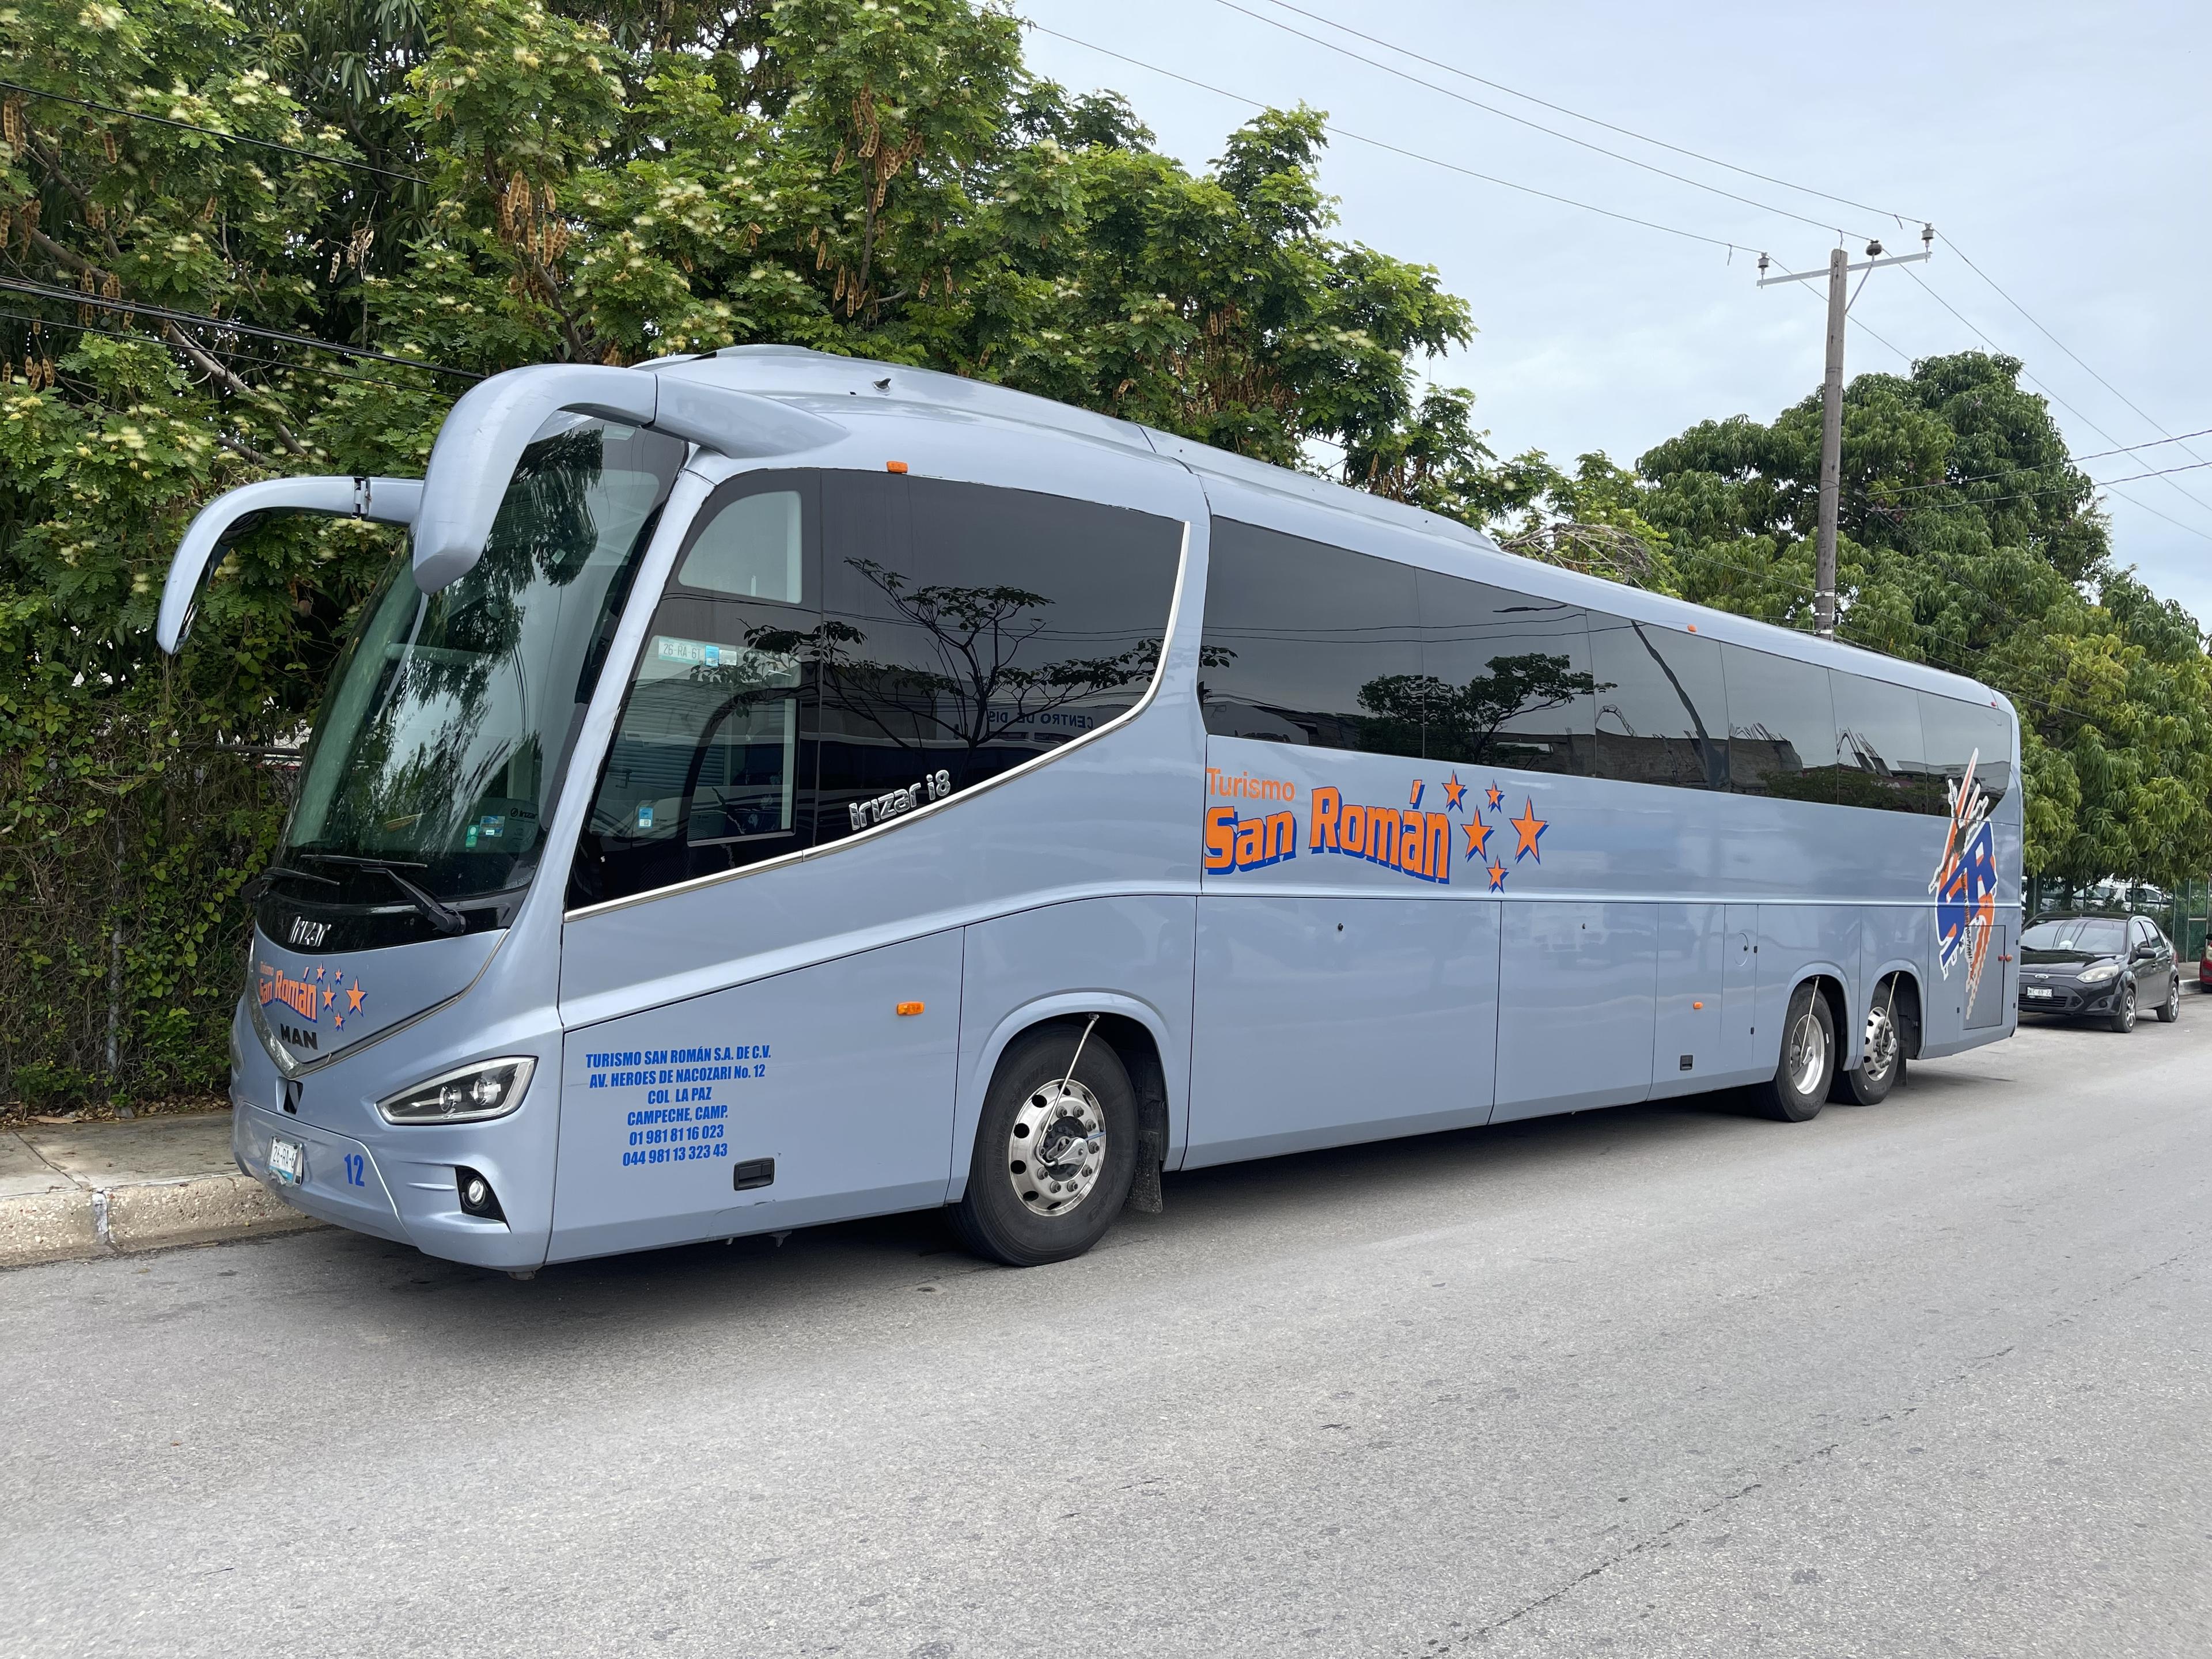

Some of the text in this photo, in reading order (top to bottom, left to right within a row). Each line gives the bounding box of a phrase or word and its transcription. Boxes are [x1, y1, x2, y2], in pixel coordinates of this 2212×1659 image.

[663, 643, 701, 660] 26-RA-6T
[926, 769, 951, 801] i8
[1206, 767, 1296, 801] Turismo
[1204, 779, 1452, 885] San Román
[260, 966, 318, 1024] San Román
[280, 1023, 319, 1051] MAN
[586, 1045, 771, 1068] TURISMO SAN ROMÁN S.A. DE C.V.
[589, 1064, 766, 1089] AV. HEROES DE NACOZARI No. 12
[675, 1088, 689, 1103] LA
[691, 1086, 713, 1101] PAZ
[627, 1105, 729, 1126] CAMPECHE, CAMP.
[629, 1124, 724, 1146] 01 981 81 16 023
[272, 1145, 296, 1169] 26-RA-6
[622, 1143, 728, 1166] 044 981 13 323 43
[343, 1153, 365, 1187] 12
